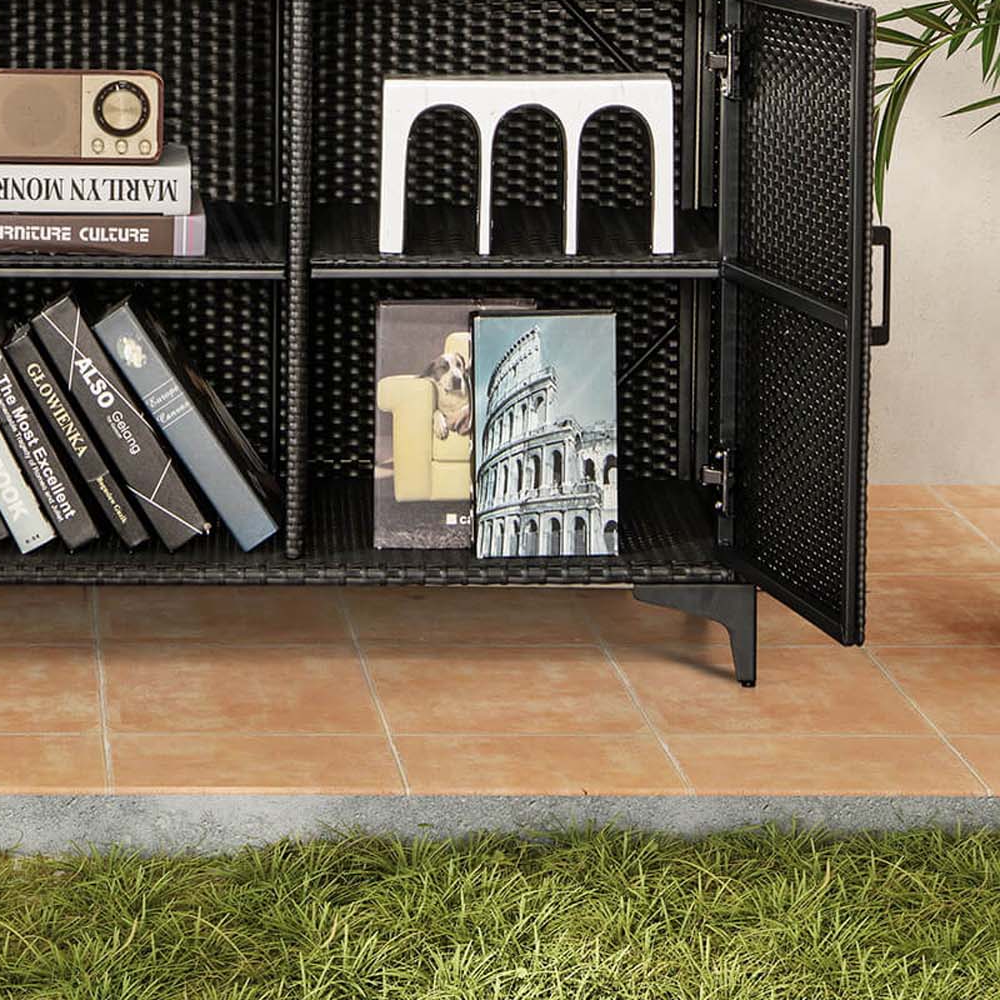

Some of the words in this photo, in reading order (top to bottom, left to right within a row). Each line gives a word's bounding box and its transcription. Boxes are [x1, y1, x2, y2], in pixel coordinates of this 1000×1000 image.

[71, 179, 178, 202] MARILYN
[79, 226, 149, 242] CULTURE
[74, 357, 115, 409] ALSO
[11, 406, 40, 447] Most
[33, 447, 76, 520] Excellent
